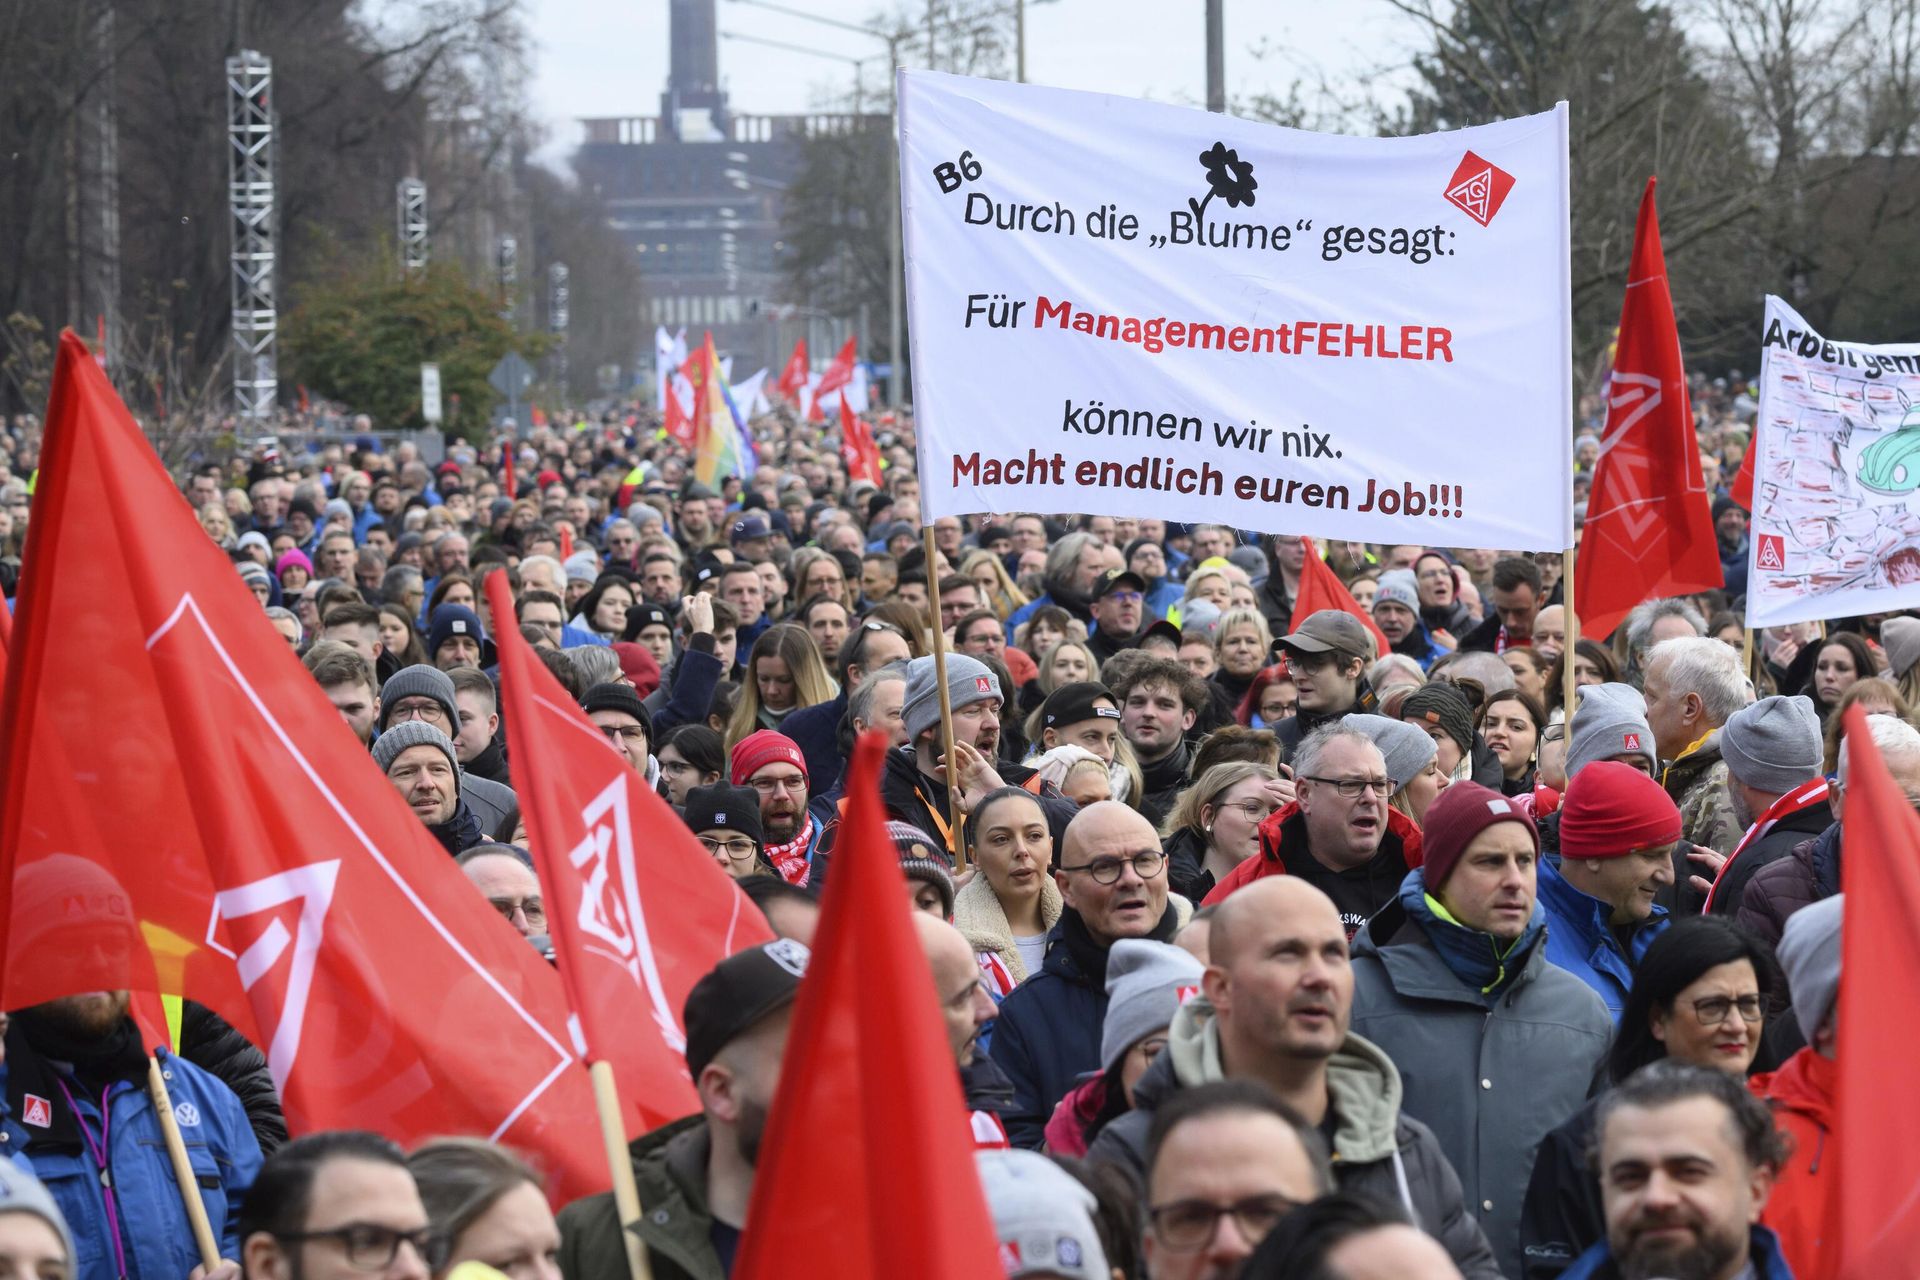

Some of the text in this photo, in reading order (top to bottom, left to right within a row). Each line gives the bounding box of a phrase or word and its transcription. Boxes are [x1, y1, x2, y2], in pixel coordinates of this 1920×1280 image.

[932, 150, 983, 195] B6
[964, 192, 1075, 236] Durch
[1085, 202, 1139, 241] die
[1321, 224, 1456, 265] gesagt:
[964, 294, 1454, 363] Für ManagementFEHLER
[1062, 399, 1343, 459] können wir nix.
[952, 448, 1463, 519] Macht endlich euren Job!!!
